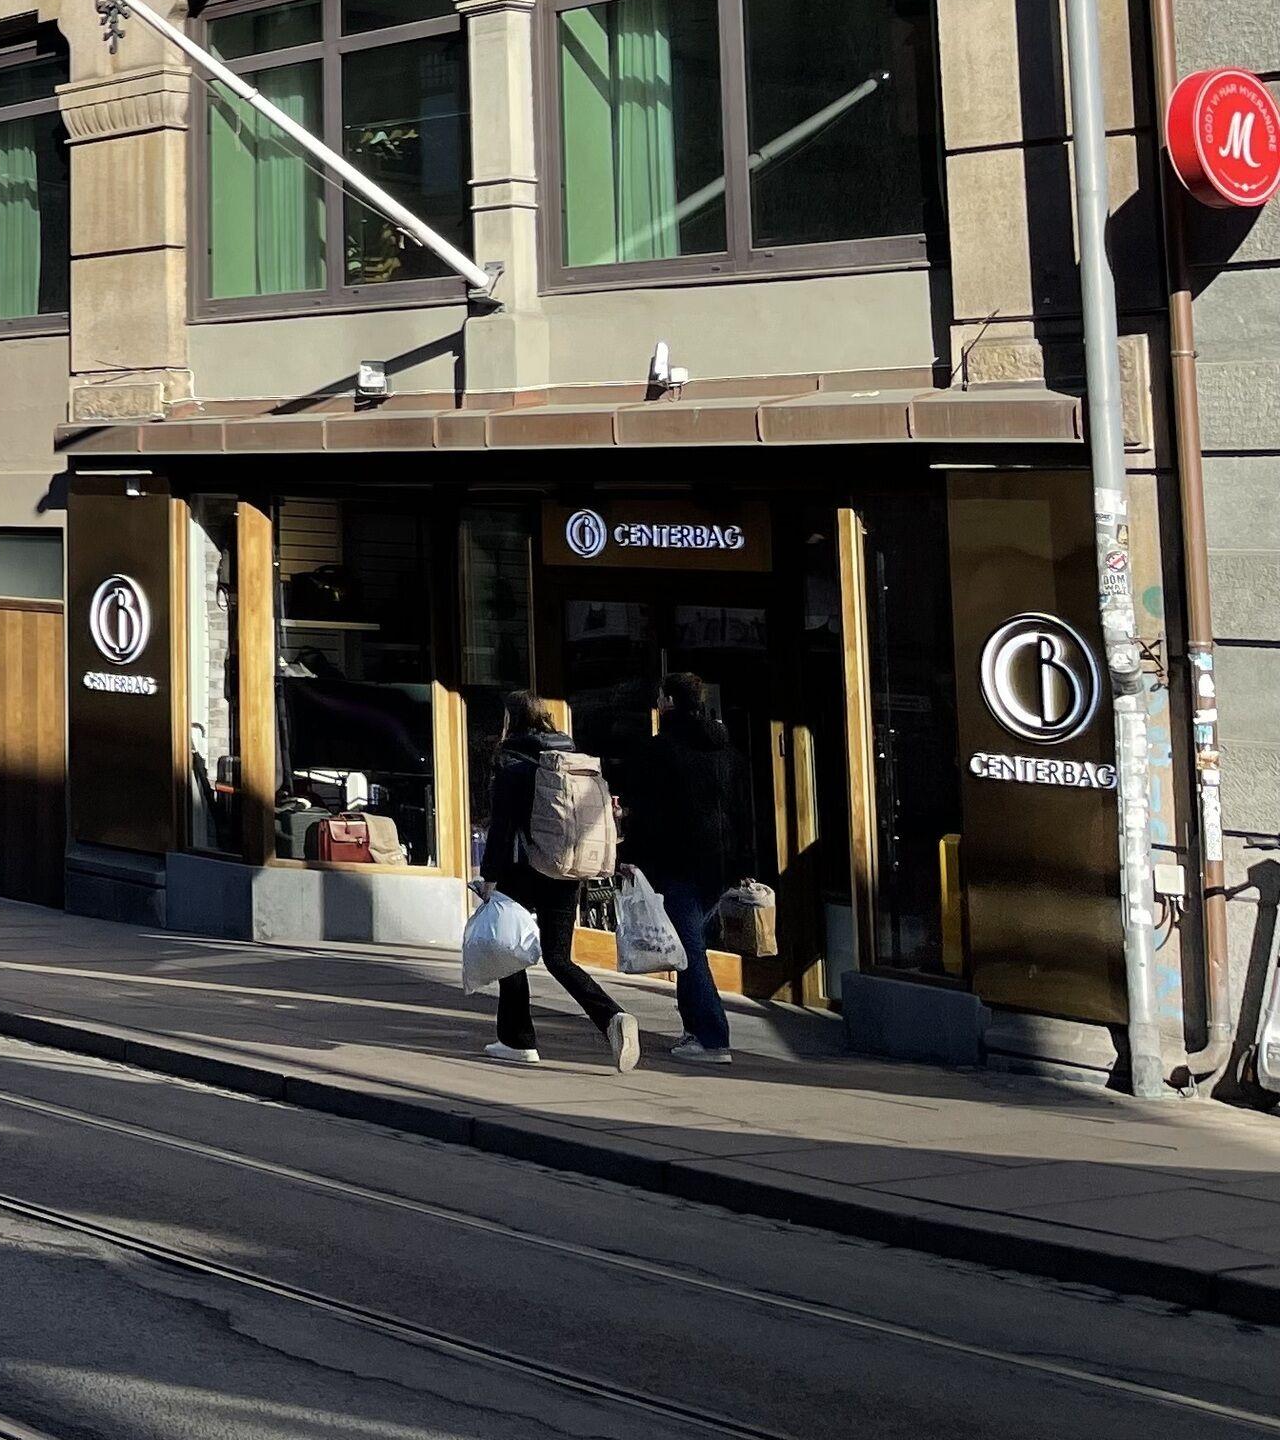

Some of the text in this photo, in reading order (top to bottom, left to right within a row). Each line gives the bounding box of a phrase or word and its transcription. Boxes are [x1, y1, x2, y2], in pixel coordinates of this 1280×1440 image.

[1219, 83, 1238, 98] HAR
[1218, 111, 1262, 168] M
[613, 523, 745, 550] CENTERBAG
[83, 671, 158, 695] CENTERBAG
[970, 752, 1117, 791] CENTERBAG
